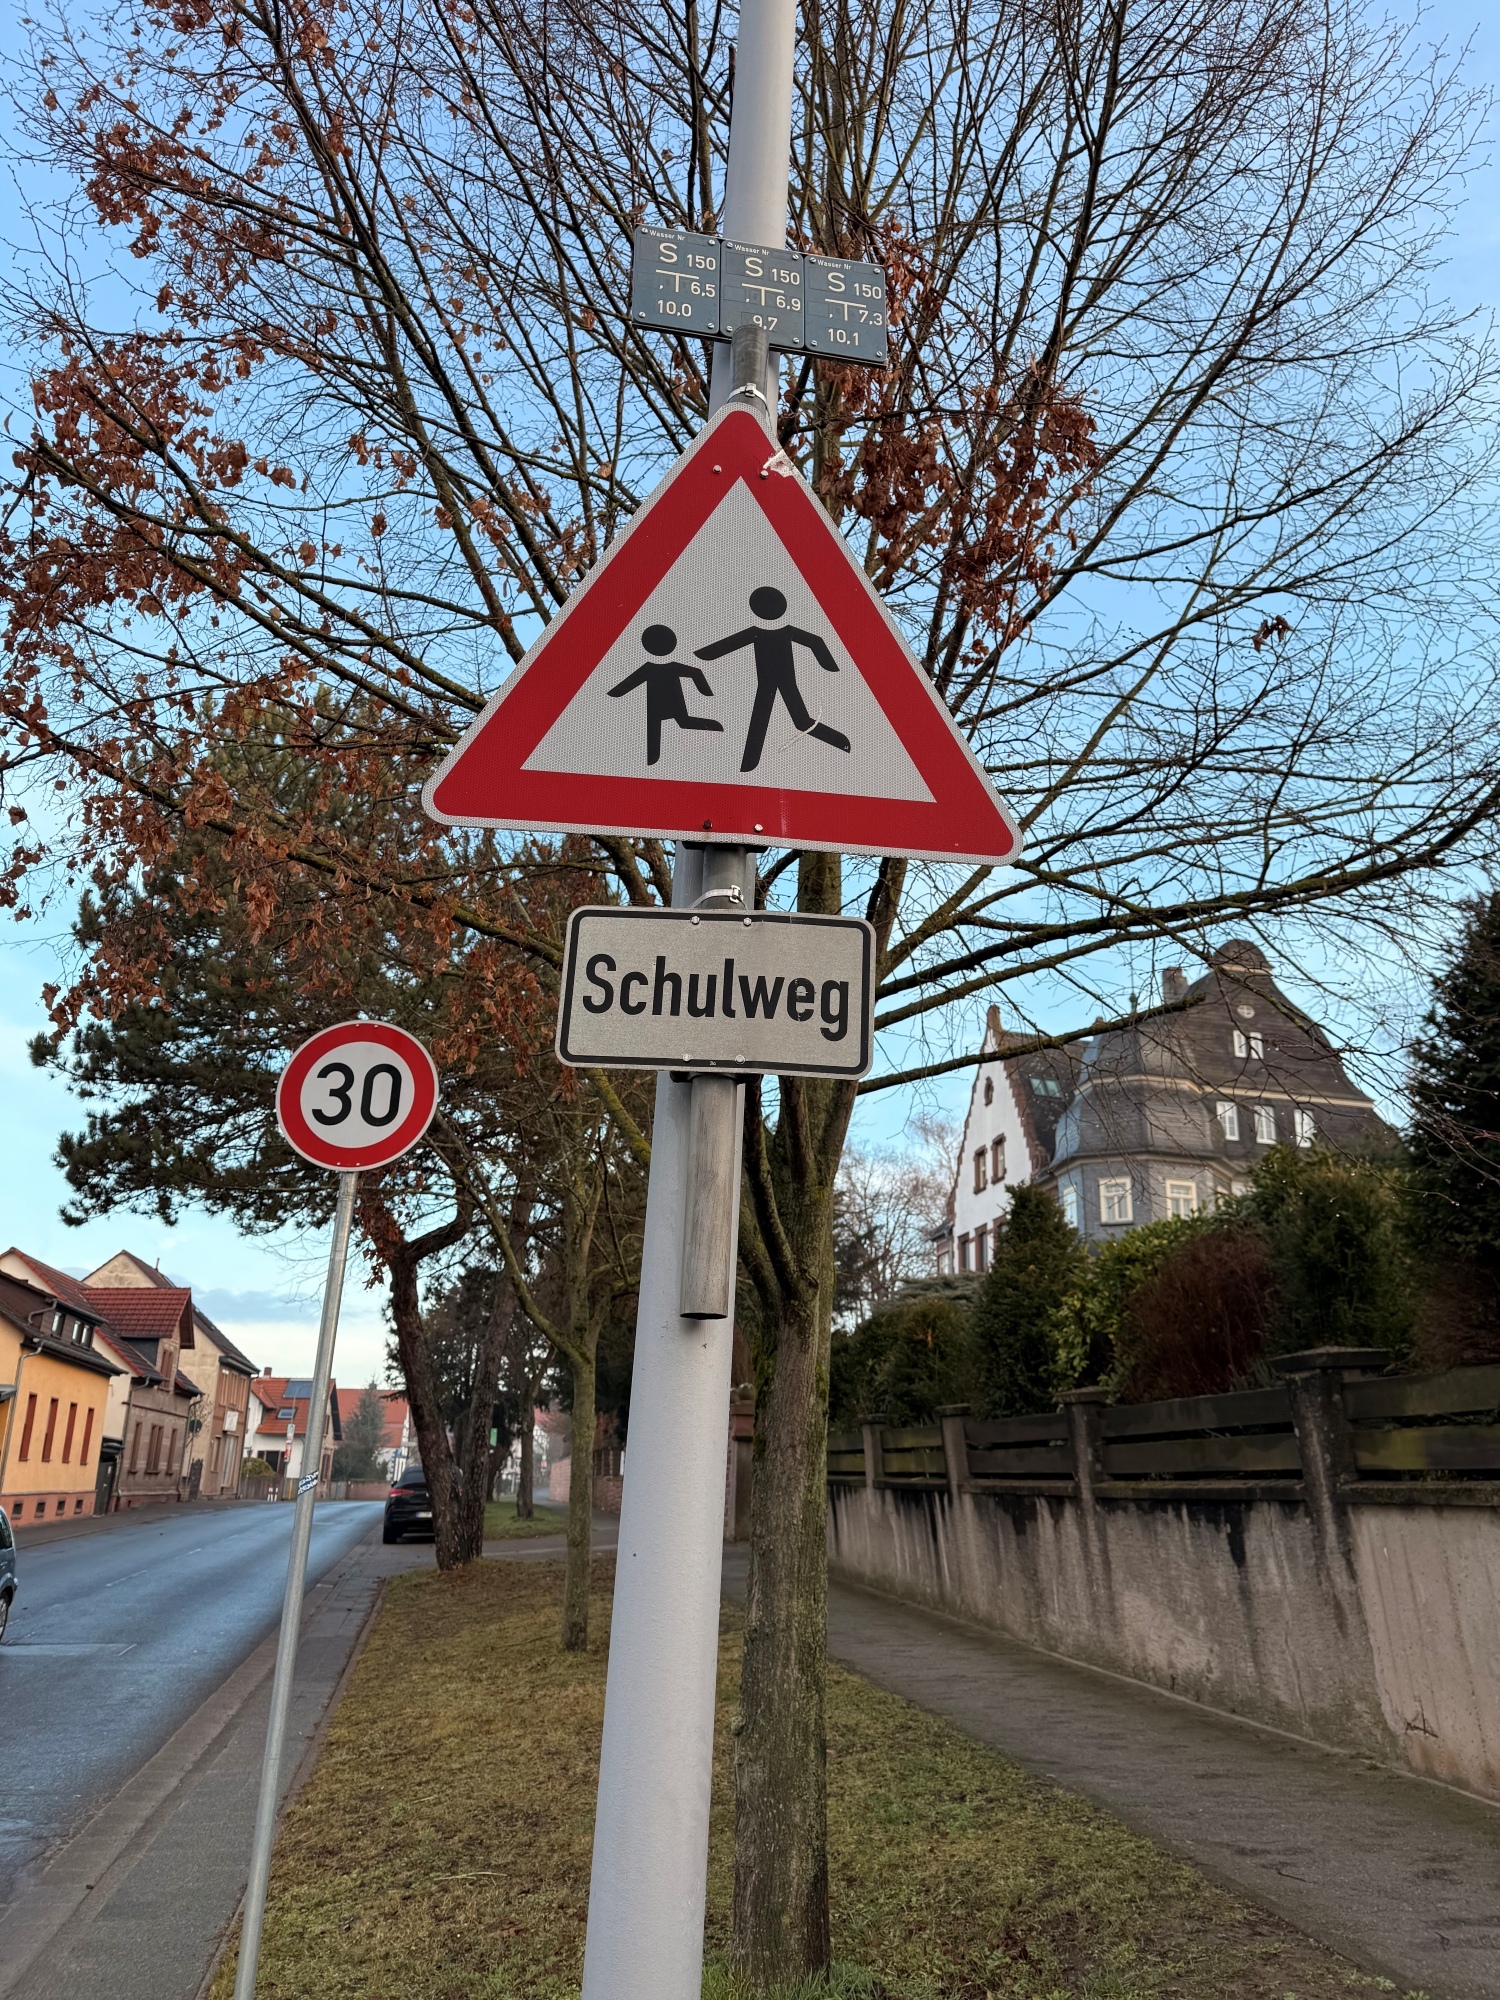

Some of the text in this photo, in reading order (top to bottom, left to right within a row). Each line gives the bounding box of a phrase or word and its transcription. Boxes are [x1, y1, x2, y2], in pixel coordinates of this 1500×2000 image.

[650, 230, 675, 239] Wasser
[660, 243, 716, 270] S 150
[734, 244, 760, 254] Wasser
[745, 257, 800, 285] S 150
[817, 259, 842, 269] Wasser
[691, 282, 716, 298] 6,5
[828, 272, 882, 299] S 150
[658, 300, 692, 317] 10,0
[776, 296, 801, 311] 6,9
[753, 315, 778, 331] 9,7
[859, 310, 882, 326] 7,3
[828, 328, 859, 346] 10,1
[583, 953, 849, 1042] Schulweg
[312, 1062, 402, 1127] 30
